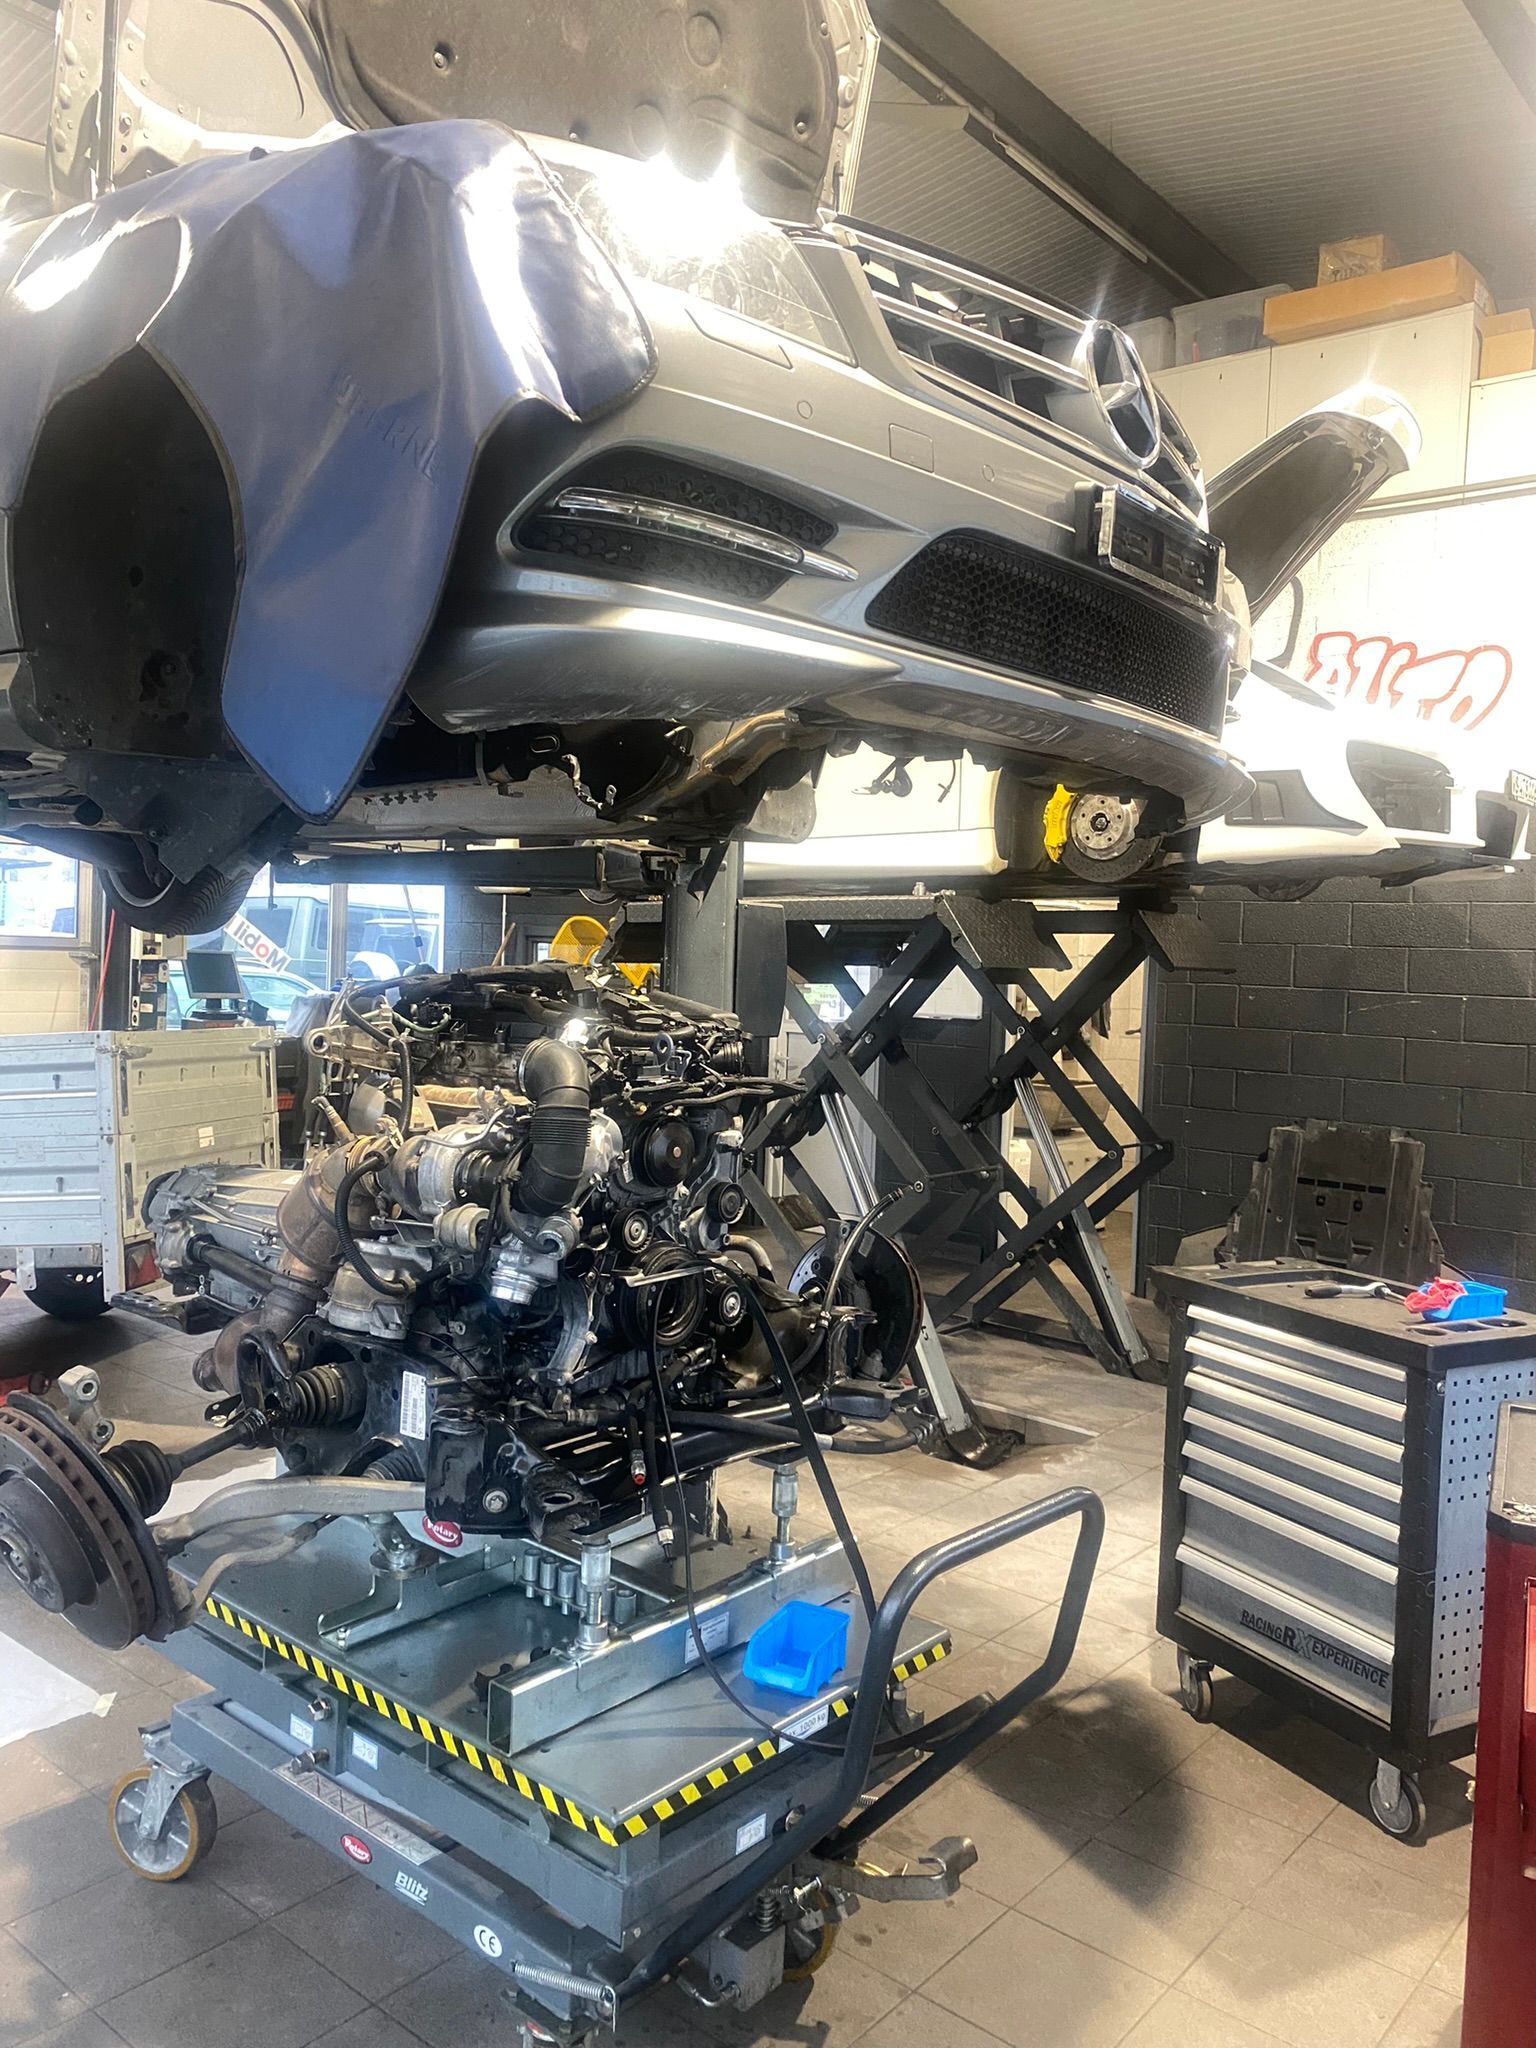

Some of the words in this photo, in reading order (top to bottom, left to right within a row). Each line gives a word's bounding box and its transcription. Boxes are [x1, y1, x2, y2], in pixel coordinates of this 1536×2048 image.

[1241, 1609, 1283, 1640] RACING
[1312, 1640, 1389, 1689] EXPERIENCE
[800, 1717, 817, 1731] 1000
[395, 1870, 429, 1901] Blitz
